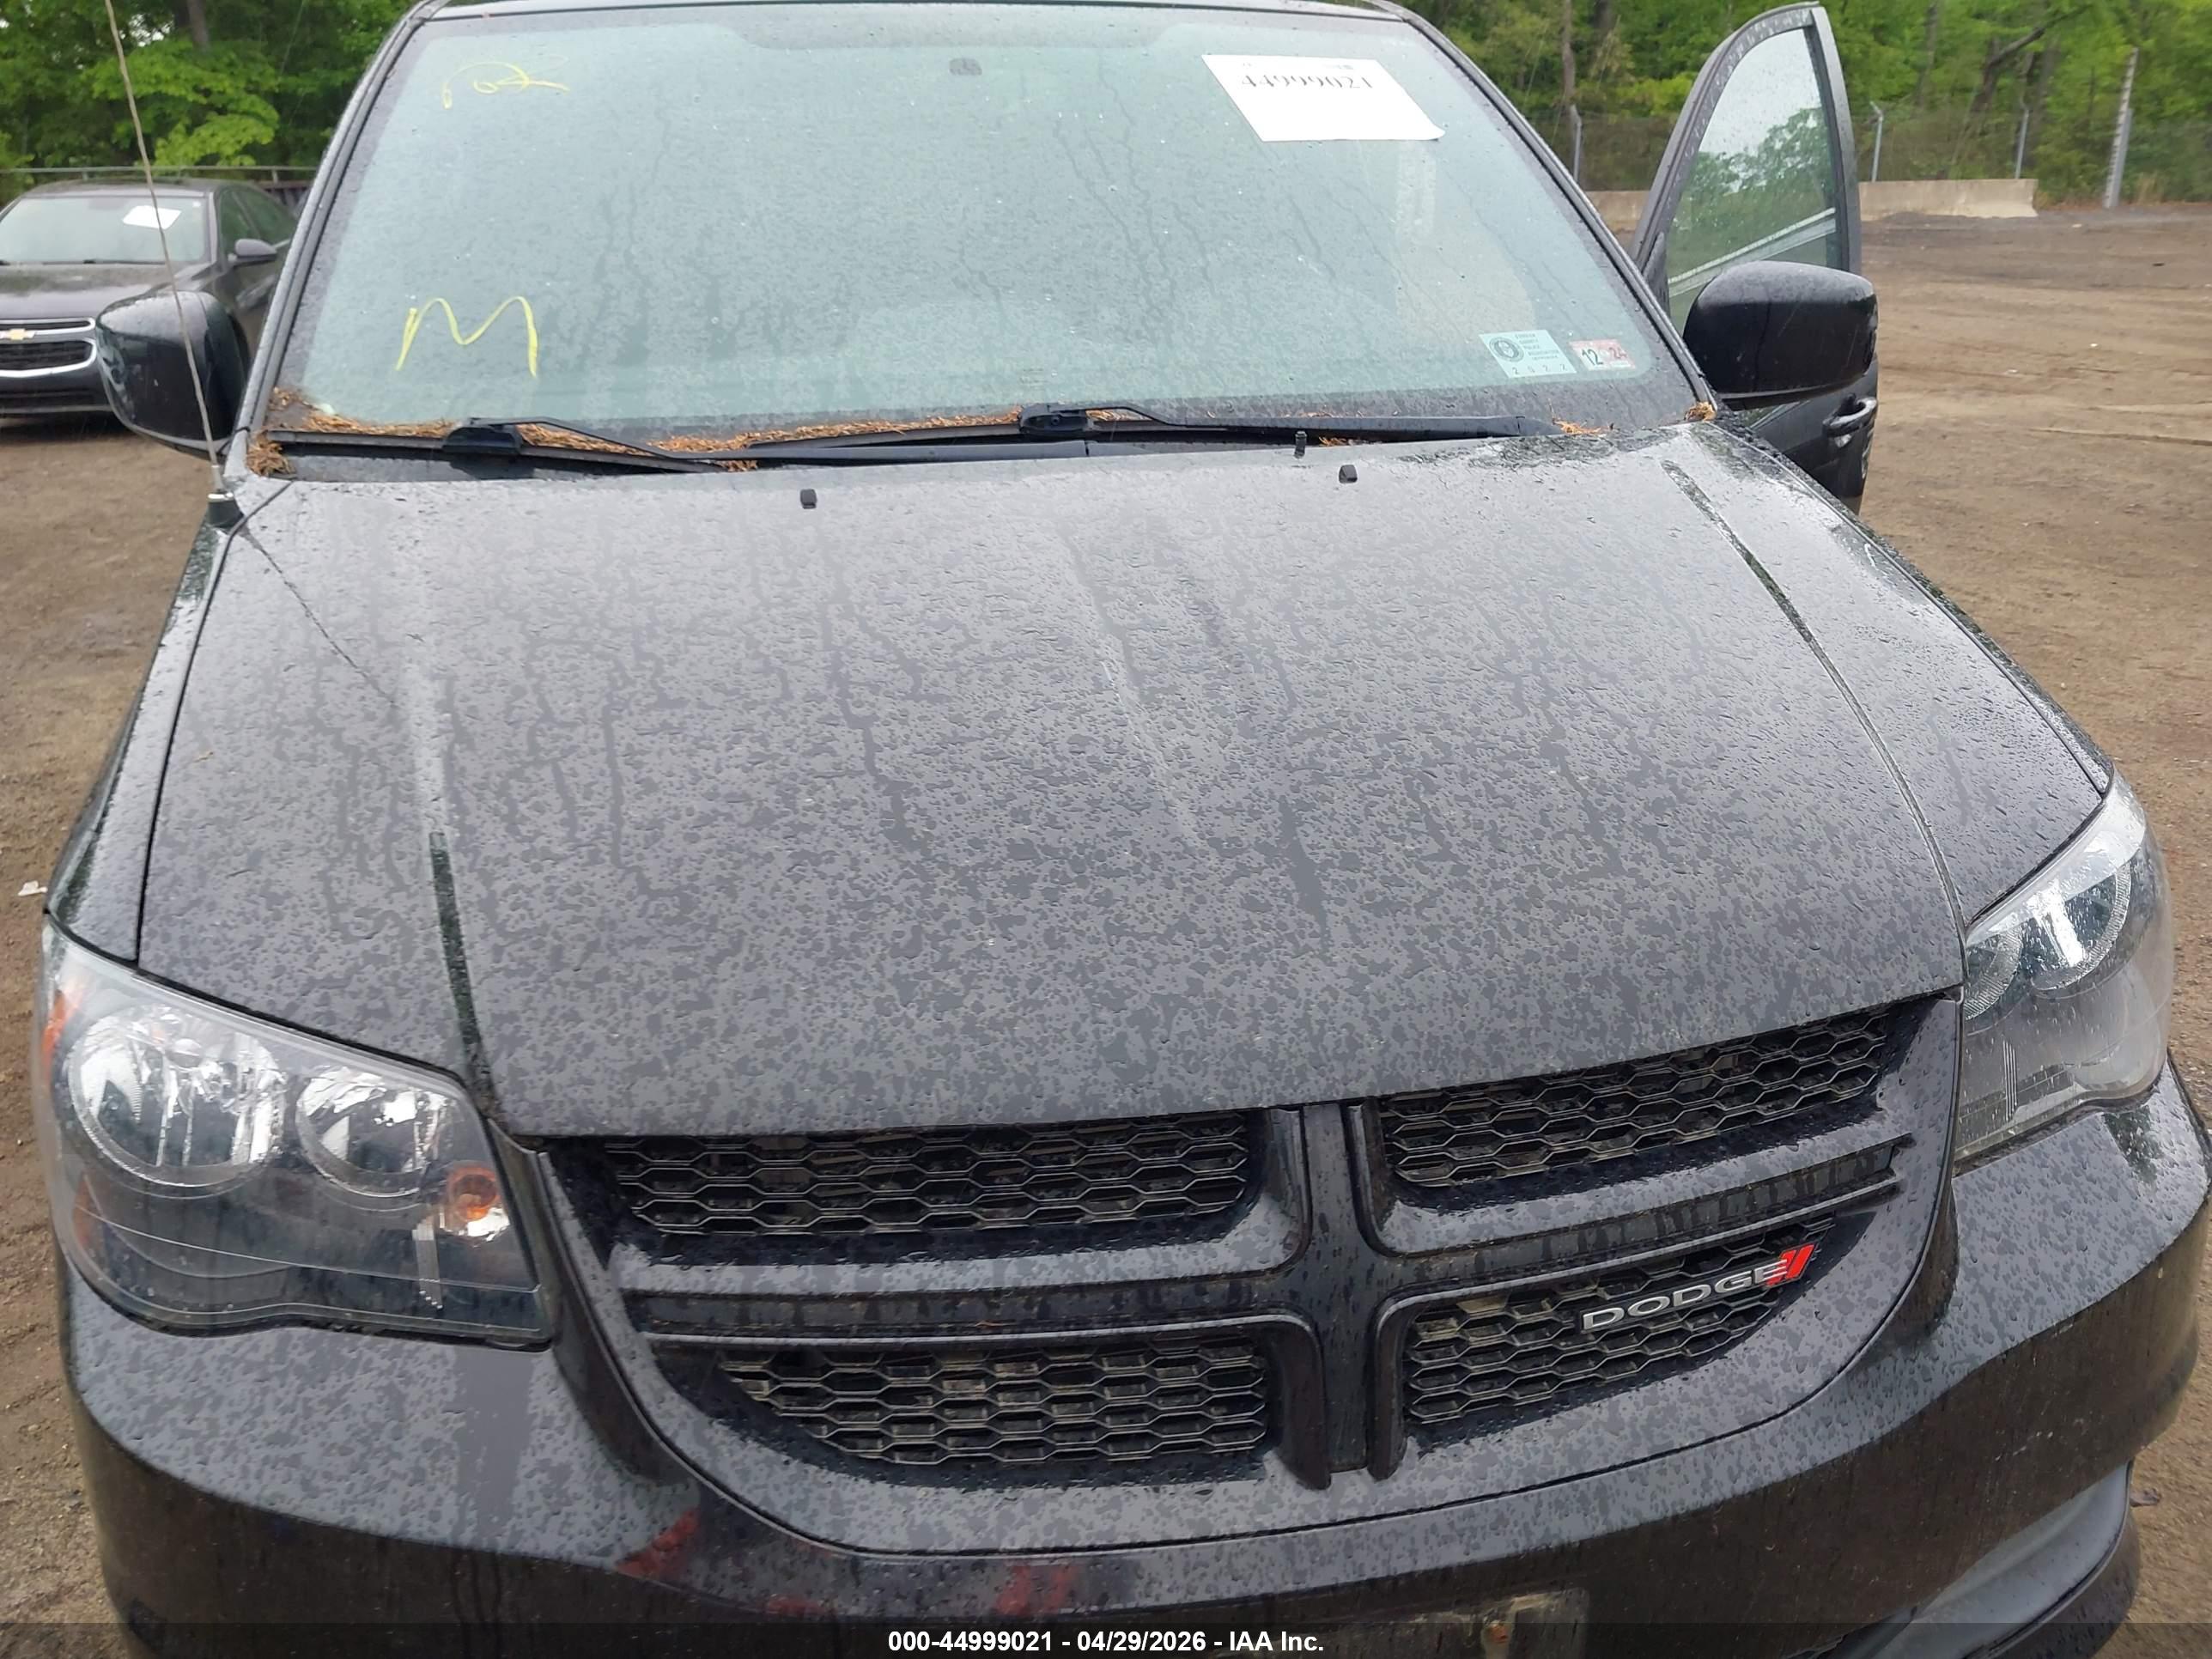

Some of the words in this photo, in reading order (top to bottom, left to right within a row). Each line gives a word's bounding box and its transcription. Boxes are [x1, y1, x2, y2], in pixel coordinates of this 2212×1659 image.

[395, 296, 538, 377] M
[1582, 348, 1604, 366] 12
[1583, 1258, 1788, 1330] DODGE
